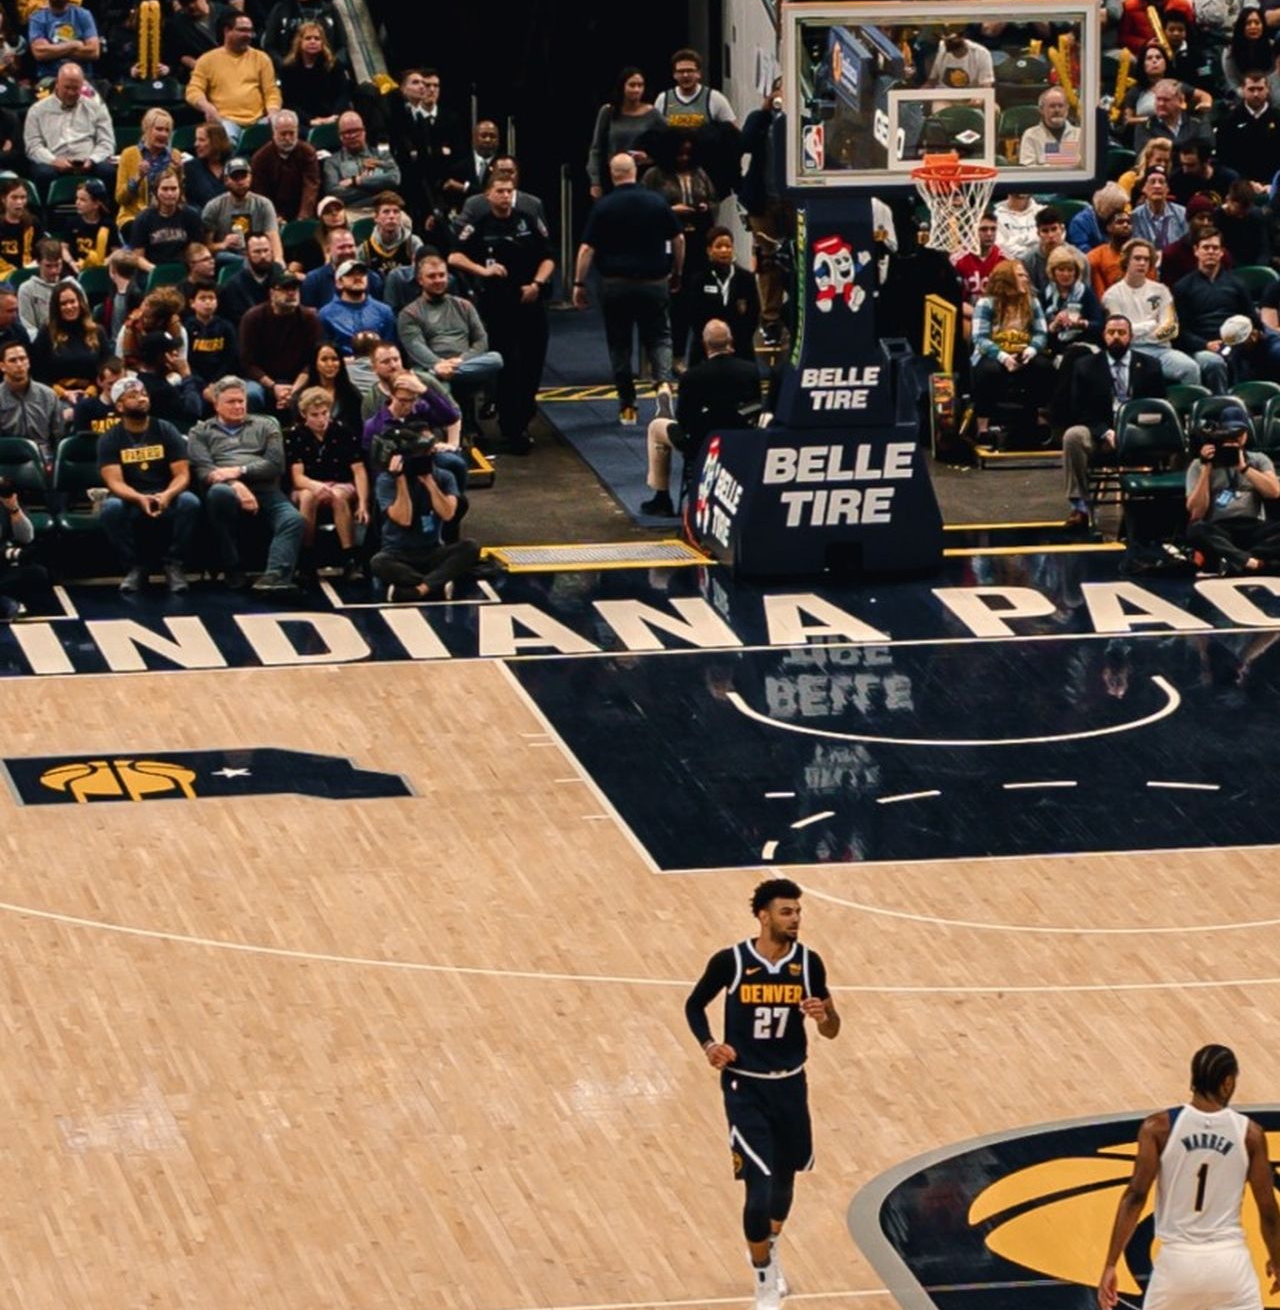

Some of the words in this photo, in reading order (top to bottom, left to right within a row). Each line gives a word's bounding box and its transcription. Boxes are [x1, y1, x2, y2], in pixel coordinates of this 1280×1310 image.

[801, 366, 880, 388] BELLE
[810, 390, 869, 410] TIRE
[763, 442, 916, 485] BELLE
[714, 468, 744, 516] BELLE
[781, 487, 895, 527] TIRE
[10, 594, 892, 675] INDIANA
[740, 984, 803, 1004] DENVER
[753, 1007, 790, 1039] 27
[1181, 1133, 1235, 1156] WARREN
[1195, 1163, 1209, 1212] 1
